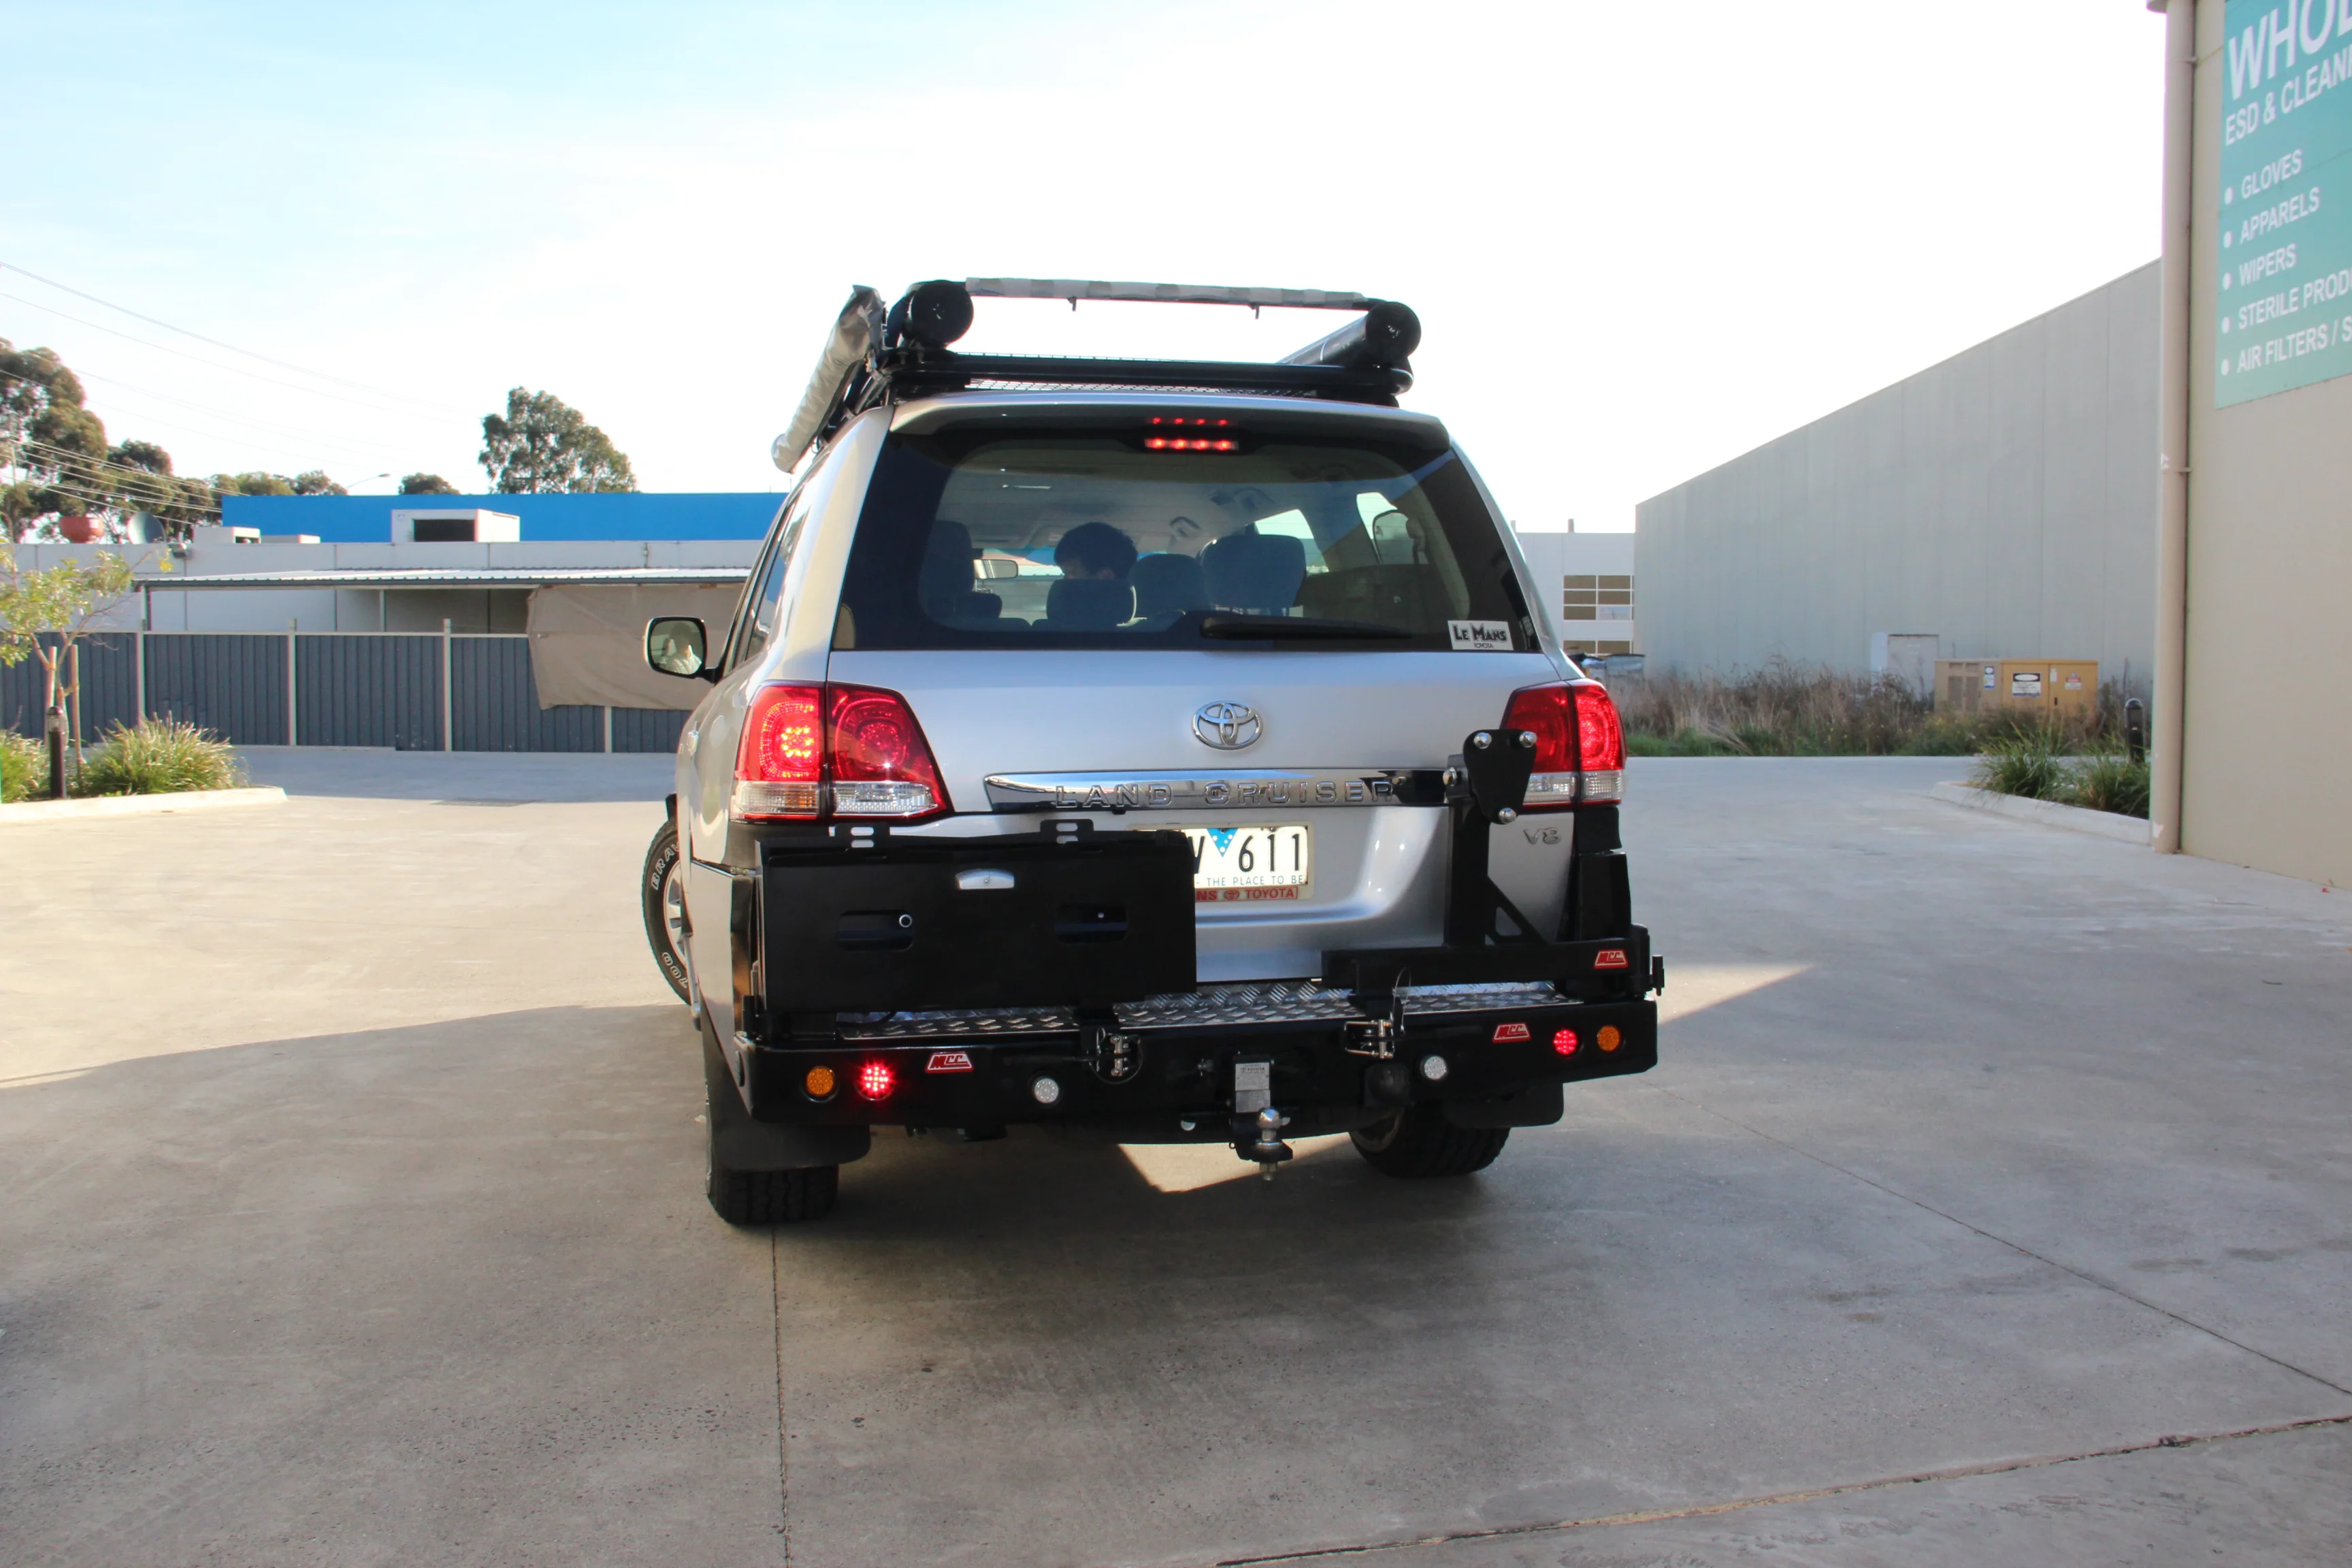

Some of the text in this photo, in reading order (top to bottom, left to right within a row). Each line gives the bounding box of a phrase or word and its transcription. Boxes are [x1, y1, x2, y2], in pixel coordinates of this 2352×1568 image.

[2225, 101, 2259, 146] ESD
[2263, 91, 2276, 125] &
[2241, 148, 2303, 199] GLOVES
[2240, 186, 2321, 245] APPARELS
[2238, 243, 2298, 286] WIPERS
[2238, 287, 2300, 330] STERILE
[2236, 344, 2262, 373] AIR
[2265, 323, 2329, 365] FILTERS
[1055, 781, 1394, 809] LAND CRUISER
[1239, 833, 1300, 873] 611
[1523, 827, 1562, 845] V8
[1207, 877, 1226, 886] THE
[1233, 876, 1264, 885] PLACE
[1271, 875, 1284, 884] TO
[1291, 875, 1303, 884] BE
[1245, 887, 1294, 899] TOYOTA
[929, 1055, 970, 1069] MCC
